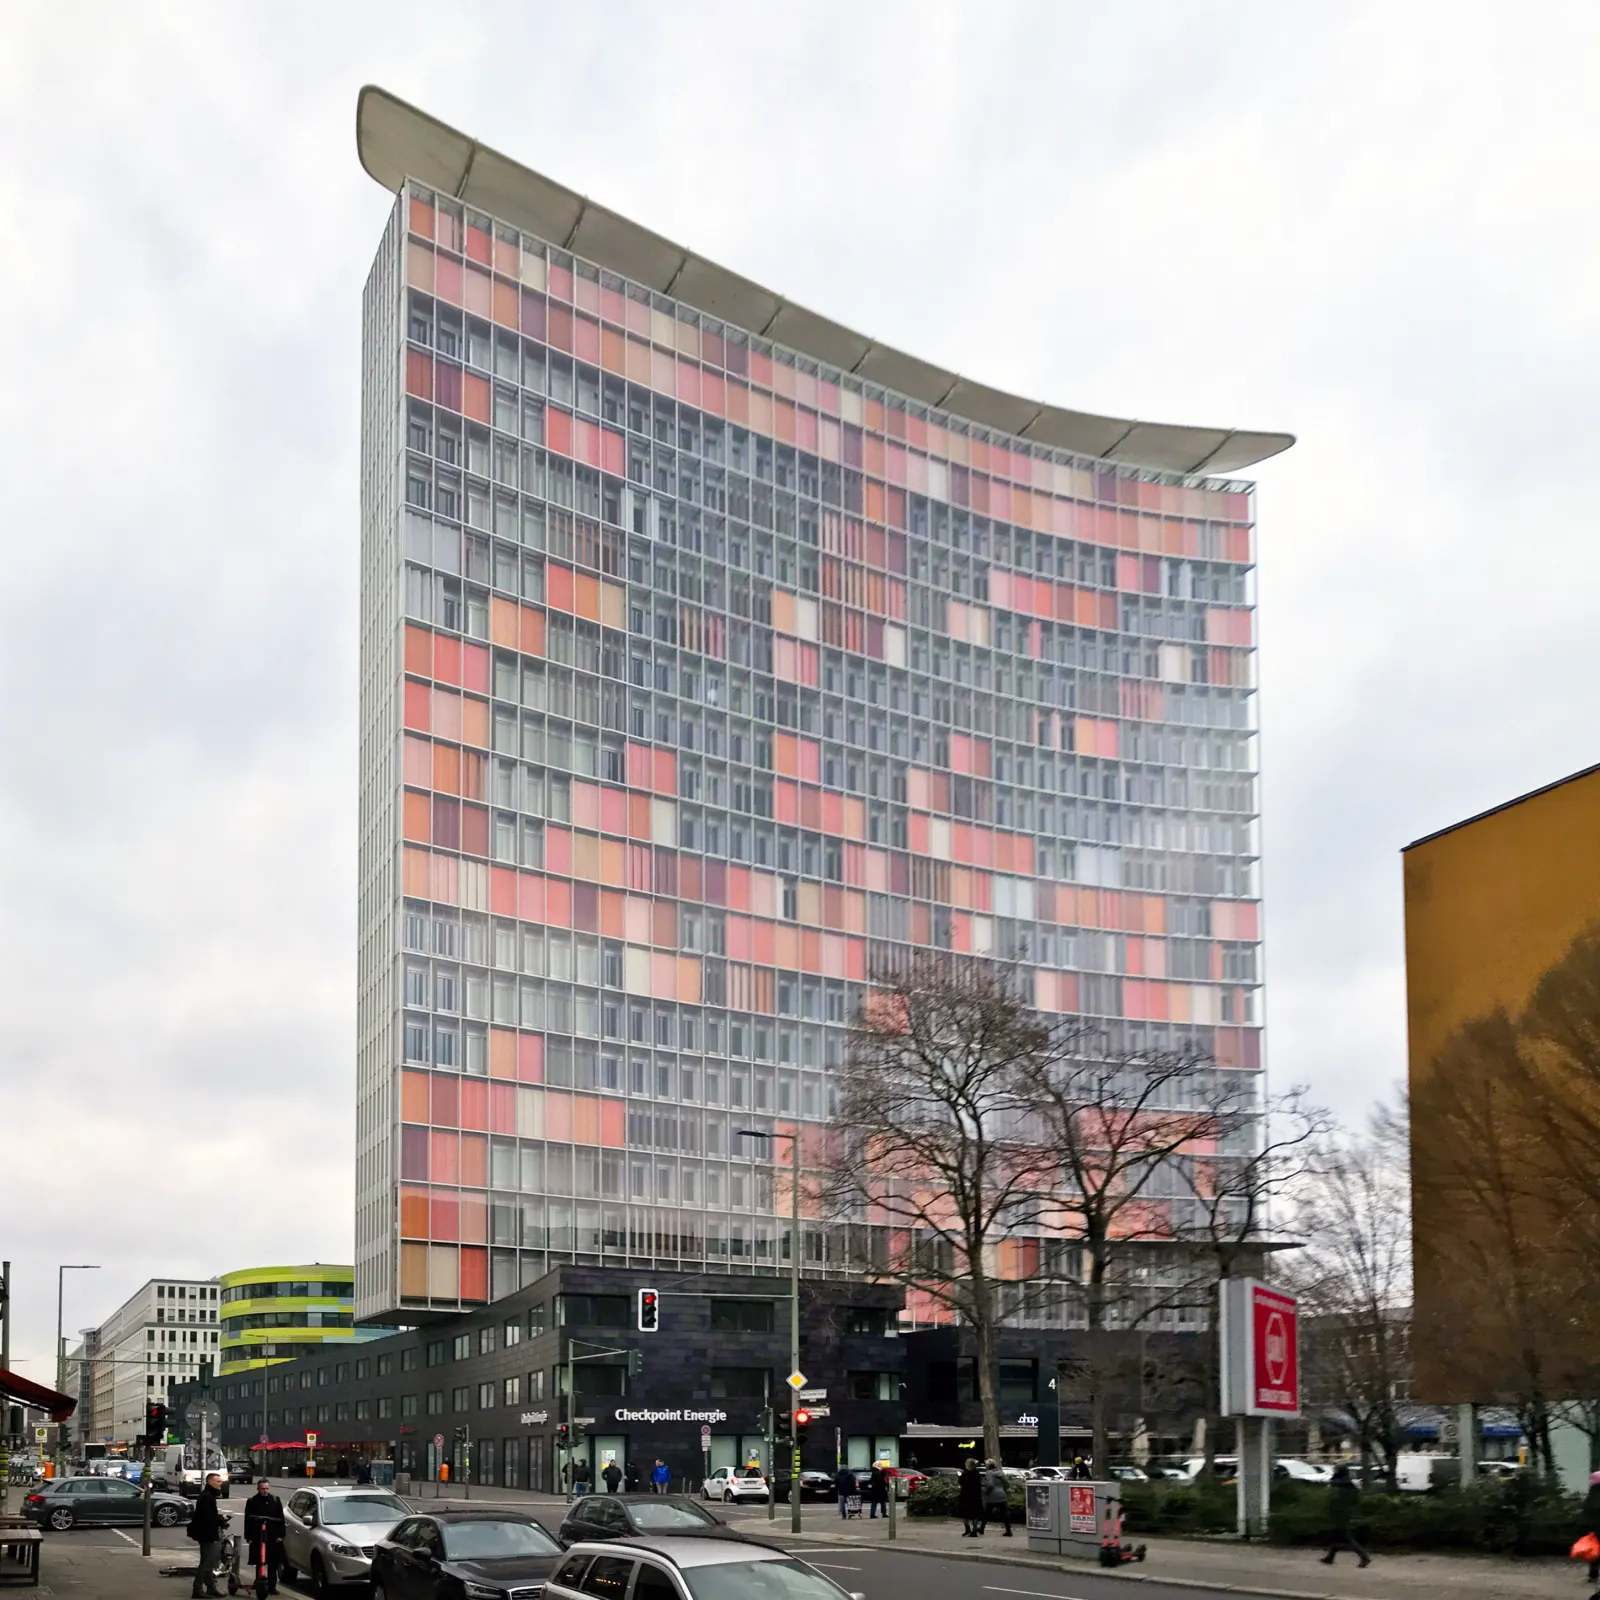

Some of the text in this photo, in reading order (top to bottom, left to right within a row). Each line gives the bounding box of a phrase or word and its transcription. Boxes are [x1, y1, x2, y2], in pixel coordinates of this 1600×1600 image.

[1048, 1378, 1056, 1390] 4
[615, 1409, 727, 1423] Checkpoint Energie
